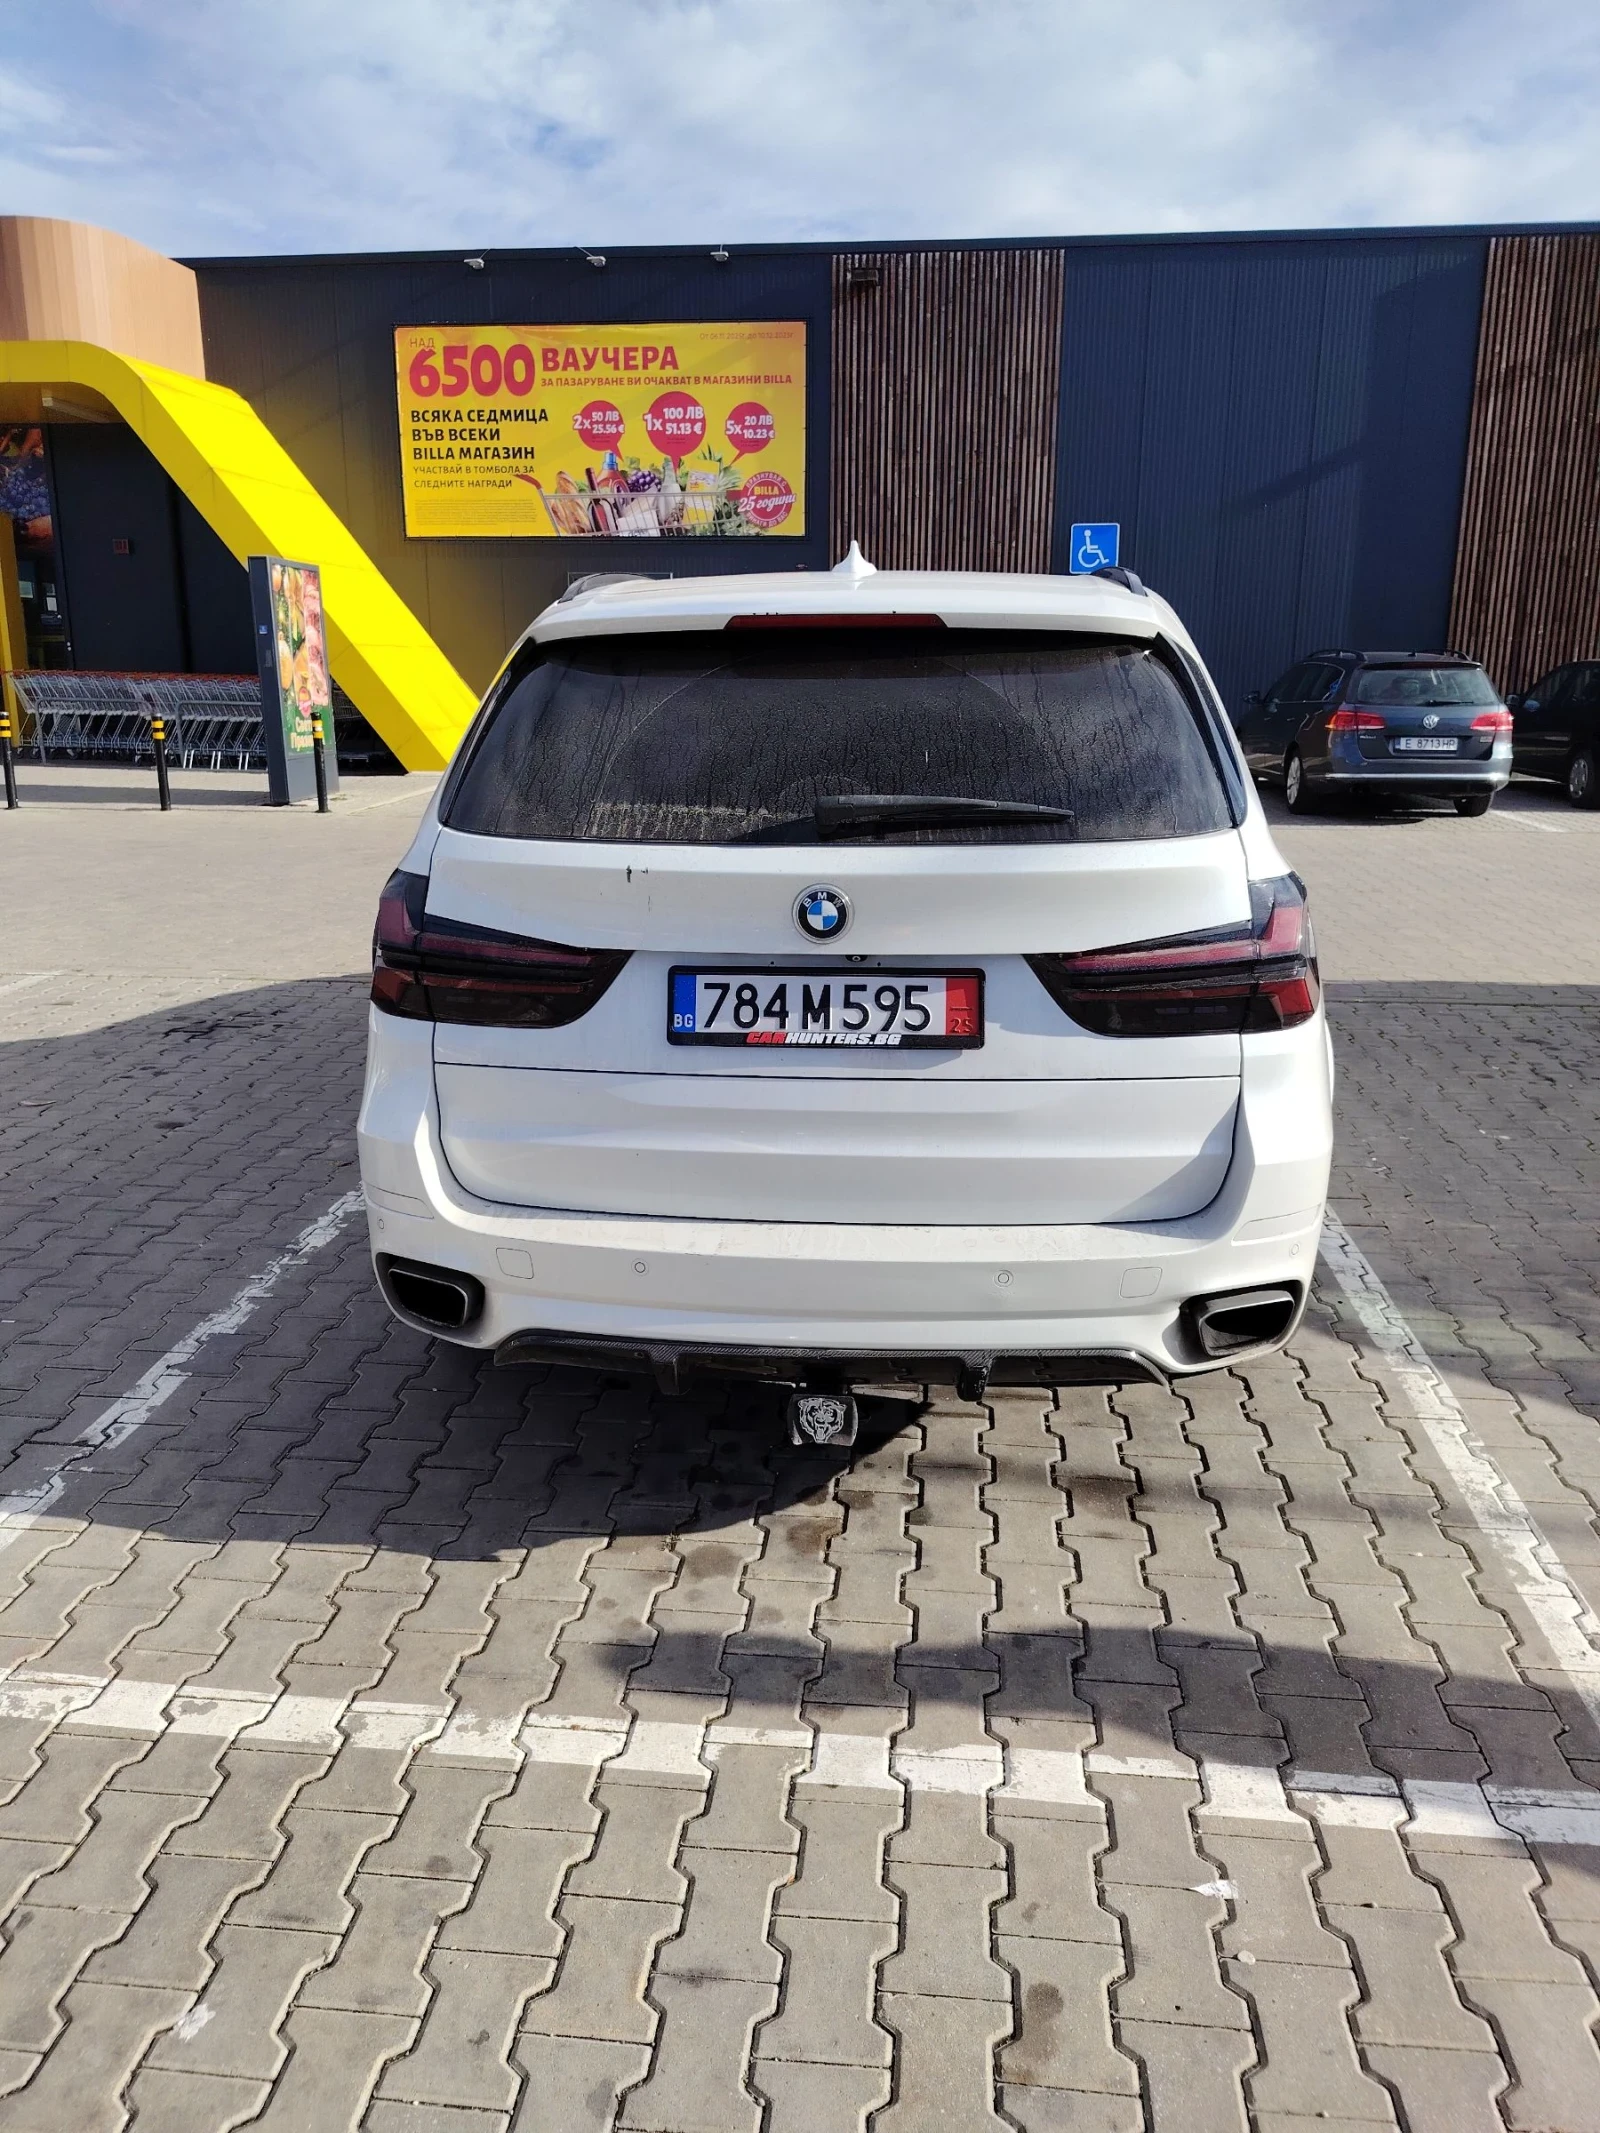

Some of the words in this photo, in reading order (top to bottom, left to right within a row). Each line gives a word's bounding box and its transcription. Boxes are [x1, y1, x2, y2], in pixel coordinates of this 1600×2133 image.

[410, 338, 435, 348] НАД
[541, 346, 679, 371] ВАУЧЕРА
[409, 344, 536, 397] 6500
[541, 378, 554, 387] ЗА
[556, 377, 625, 387] ПАЗАРУВАНЕ
[627, 377, 641, 386] ВИ
[643, 376, 692, 386] ОЧАКВАТ
[694, 376, 701, 385] В
[703, 375, 761, 385] МАГАЗИНИ
[764, 374, 793, 384] BILLA
[411, 410, 463, 423] ВСЯКА
[467, 409, 549, 424] СЕДМИЦА
[592, 412, 603, 422] 50
[605, 411, 620, 421] ЛВ
[663, 407, 684, 420] 100
[685, 406, 704, 419] ЛВ
[744, 416, 757, 426] 20
[758, 415, 773, 426] ЛВ
[412, 429, 444, 441] ВЪВ
[448, 428, 500, 441] ВСЕКИ
[592, 424, 617, 434] 25.56
[618, 424, 625, 433] €
[665, 422, 692, 435] 51.13
[693, 422, 703, 434] €
[743, 429, 767, 439] 10.23
[768, 430, 775, 439] €
[413, 448, 455, 460] BILLA
[459, 447, 535, 460] МАГАЗИН
[413, 464, 463, 475] УЧАСТВАЙ
[466, 466, 472, 474] В
[474, 466, 520, 475] ТОМБОЛА
[522, 466, 535, 474] ЗА
[414, 480, 465, 489] СЛЕДНИТЕ
[468, 480, 513, 489] НАГРАДИ
[754, 486, 779, 495] BILLA
[738, 496, 757, 513] 25
[756, 495, 796, 512] години
[1405, 739, 1412, 749] E
[1416, 738, 1441, 749] 8713
[1442, 739, 1456, 749] HP
[802, 891, 844, 908] BMW
[703, 982, 789, 1030] 784
[802, 984, 831, 1030] M
[842, 984, 931, 1032] 595
[673, 1013, 694, 1028] BG
[951, 1017, 973, 1033] 25
[746, 1031, 902, 1046] CARHUNTERS.BG
